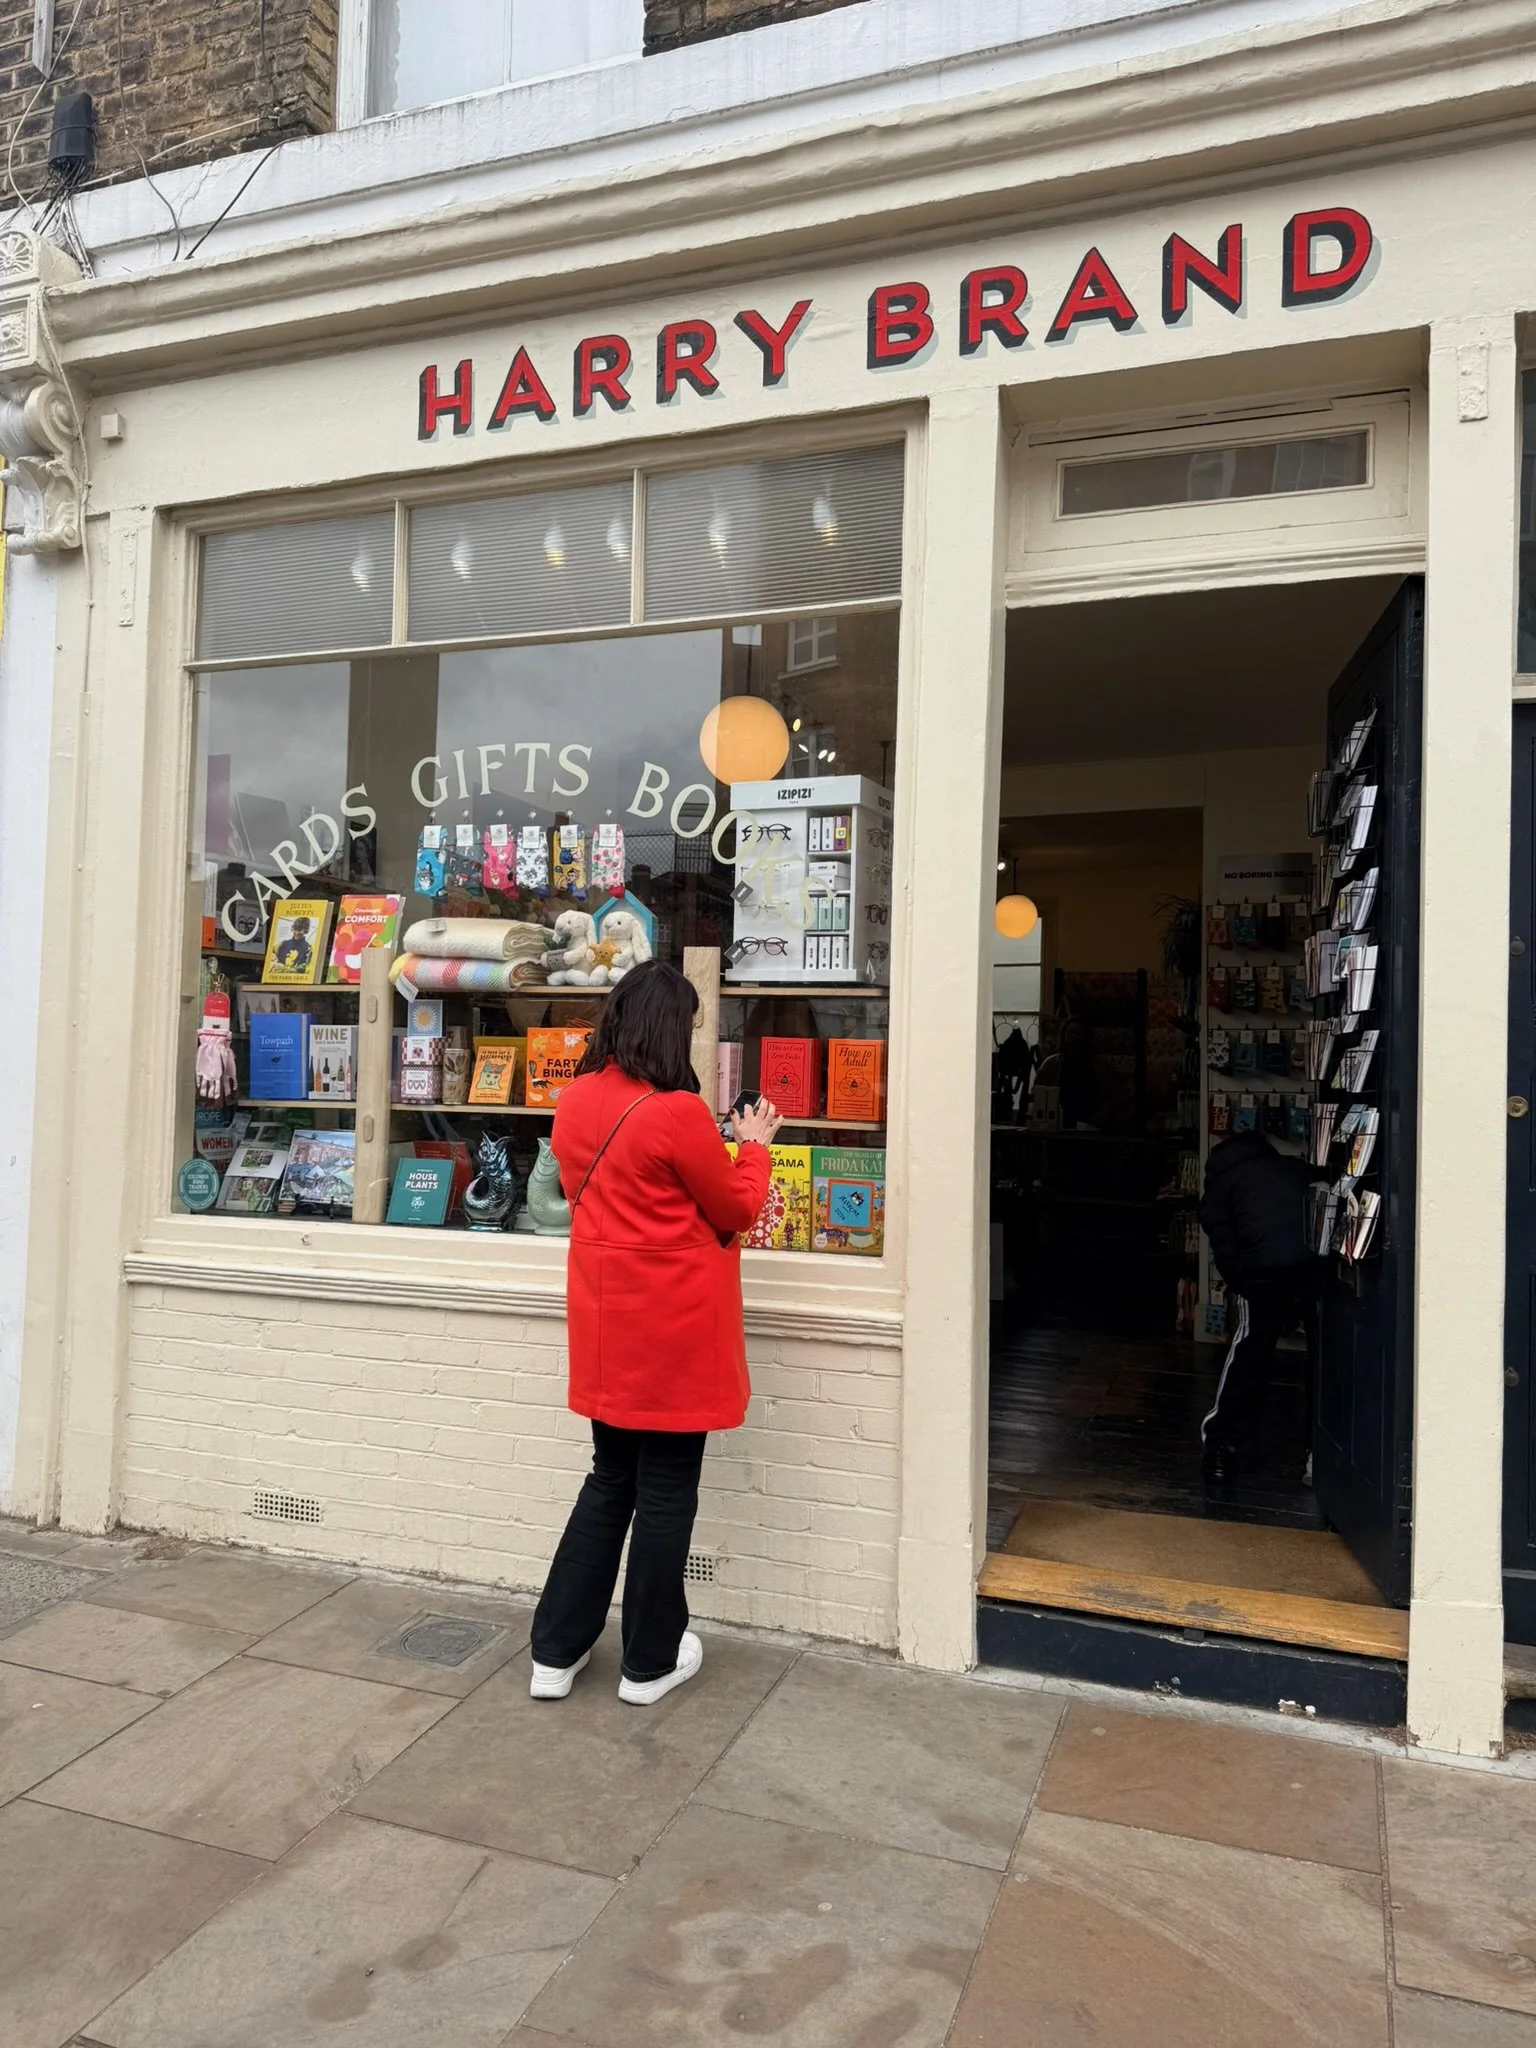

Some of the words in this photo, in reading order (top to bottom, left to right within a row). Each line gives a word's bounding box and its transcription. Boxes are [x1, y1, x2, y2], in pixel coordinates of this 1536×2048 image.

[418, 299, 814, 442] HARRY
[866, 206, 1378, 371] BRAND
[777, 787, 812, 801] IZIPIZI
[221, 782, 378, 943] CARDS
[411, 742, 593, 809] GIFTS
[627, 761, 836, 930] BOOKS
[1224, 872, 1237, 880] NO
[1239, 871, 1273, 879] BORING
[344, 915, 389, 923] COMFORT
[313, 1028, 348, 1040] WINE
[259, 1035, 294, 1048] Towpath
[838, 1047, 862, 1058] How
[863, 1049, 872, 1057] to
[547, 1058, 578, 1068] FART
[842, 1057, 868, 1068] Adult
[543, 1068, 575, 1078] BING
[197, 1111, 221, 1121] ROPE
[771, 1158, 805, 1168] SAMA
[820, 1157, 860, 1171] FRIDA
[408, 1172, 438, 1181] HOUSE
[405, 1180, 438, 1190] PLANTS
[838, 1195, 861, 1218] JELLYCAT
